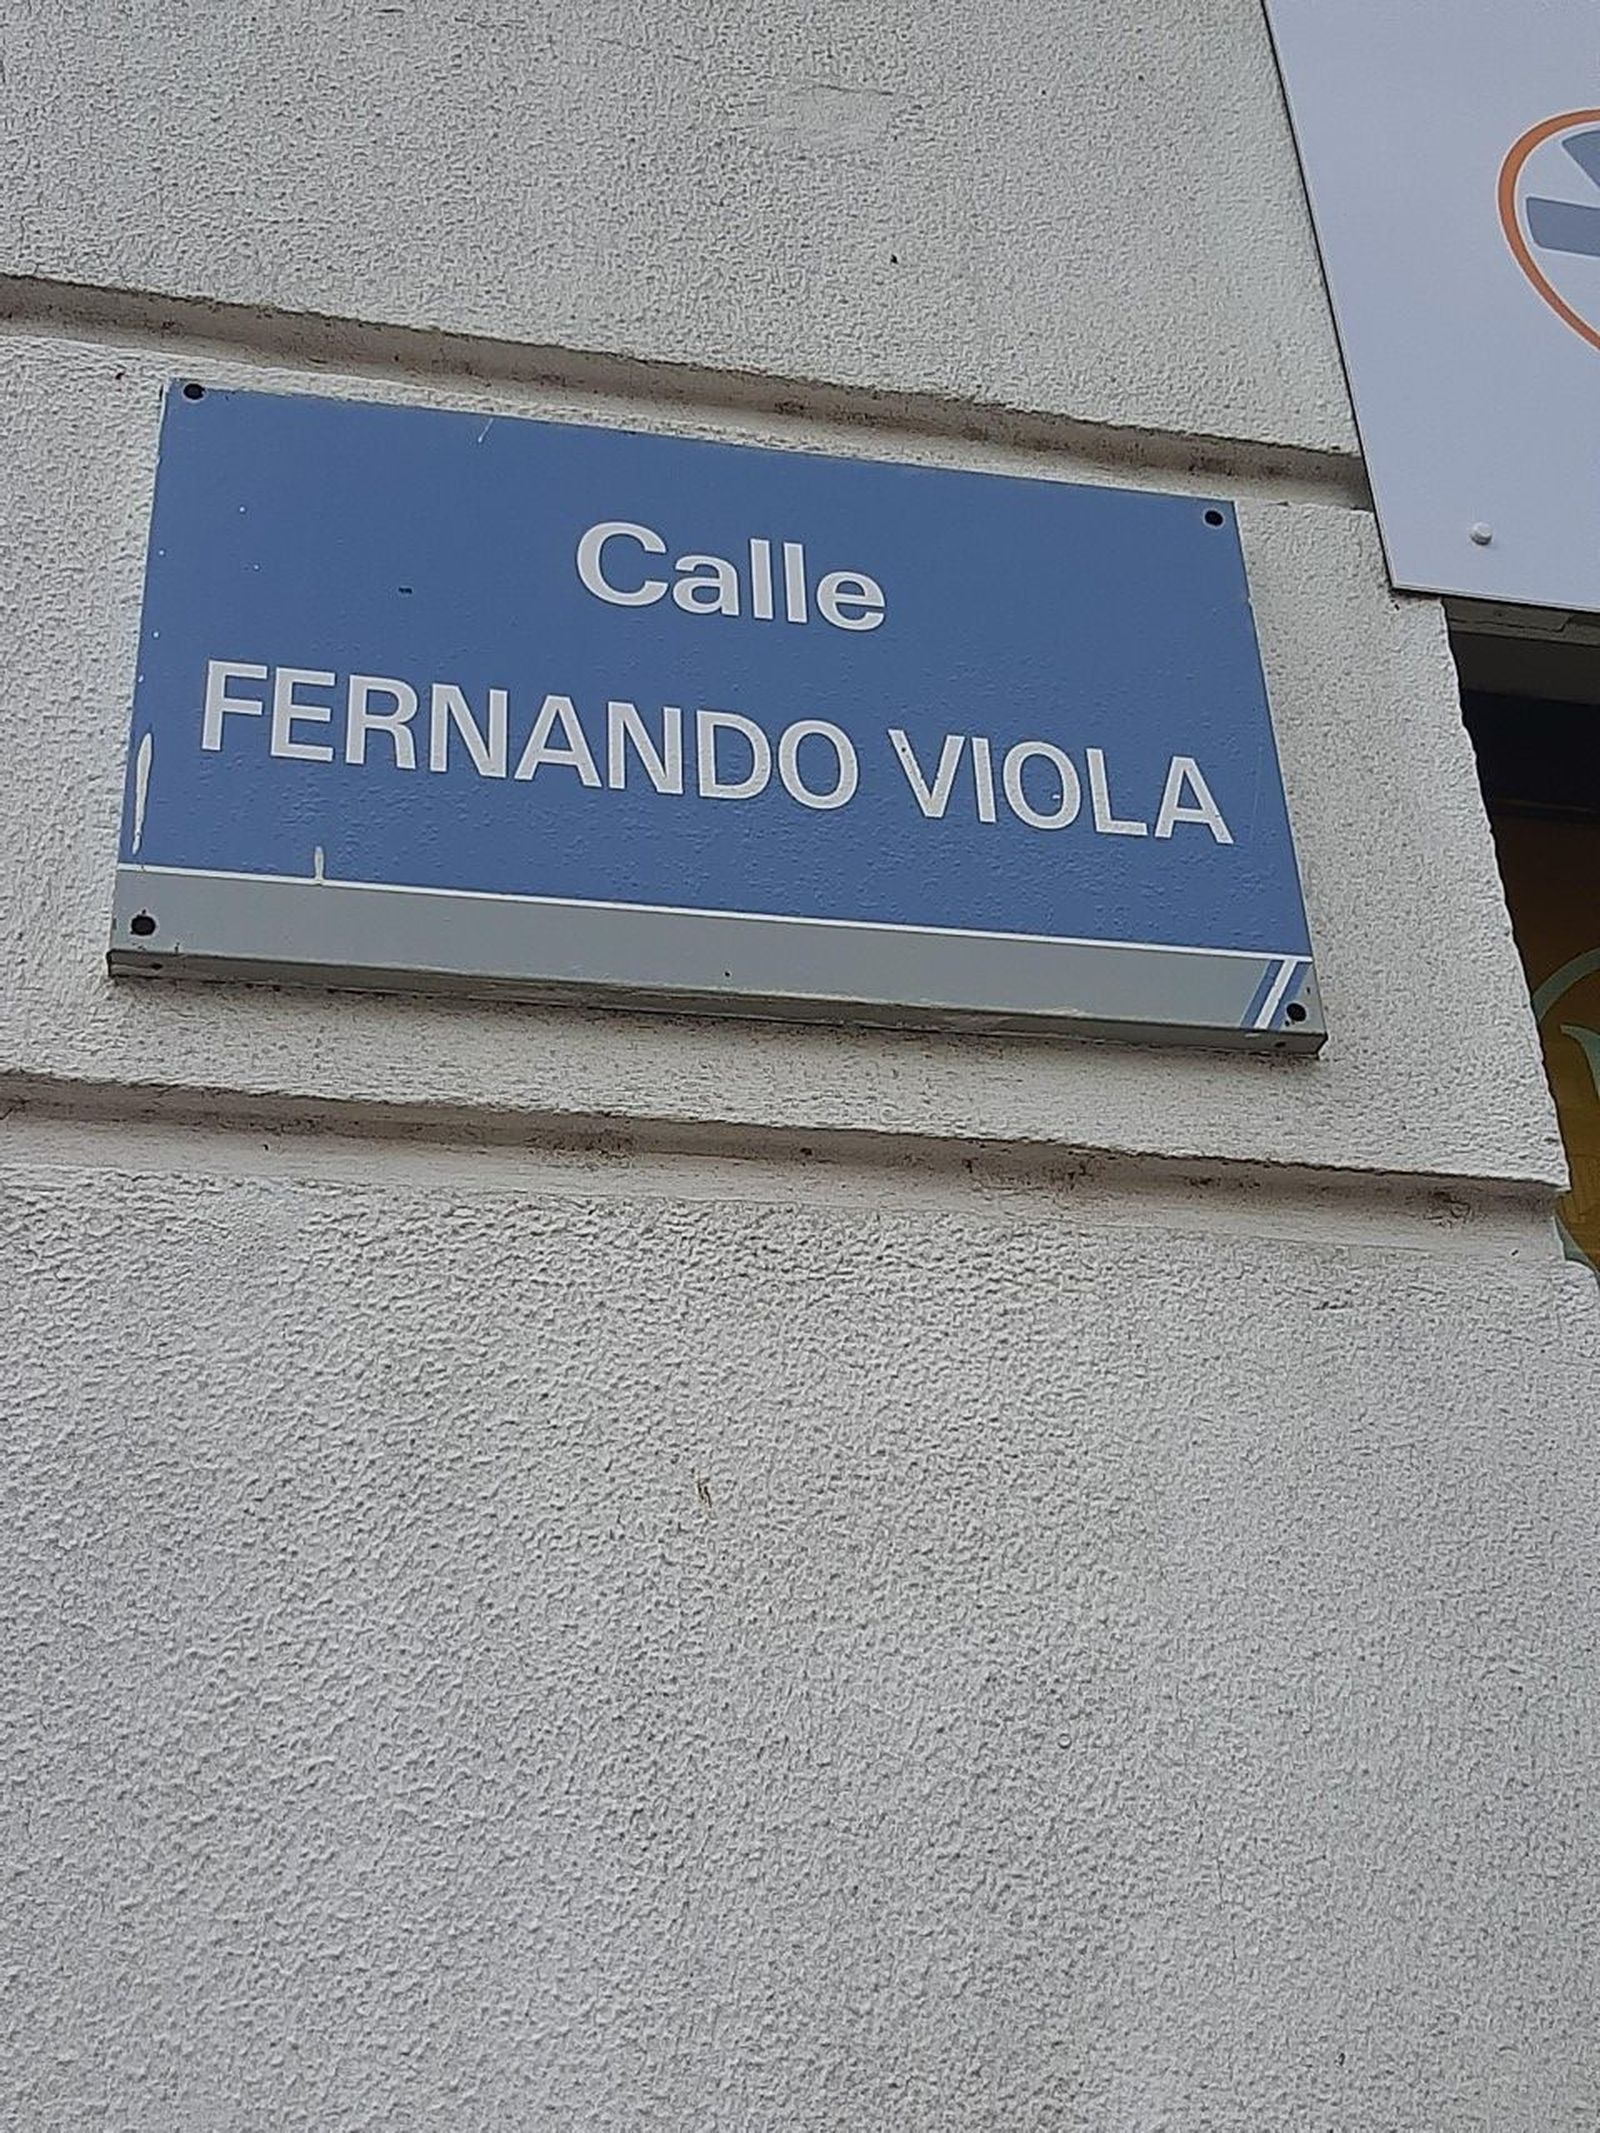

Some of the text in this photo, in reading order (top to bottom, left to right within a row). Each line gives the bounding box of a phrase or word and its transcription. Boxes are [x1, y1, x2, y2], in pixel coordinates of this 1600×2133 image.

[576, 521, 886, 632] Calle
[201, 659, 1234, 845] FERNANDO VIOLA
